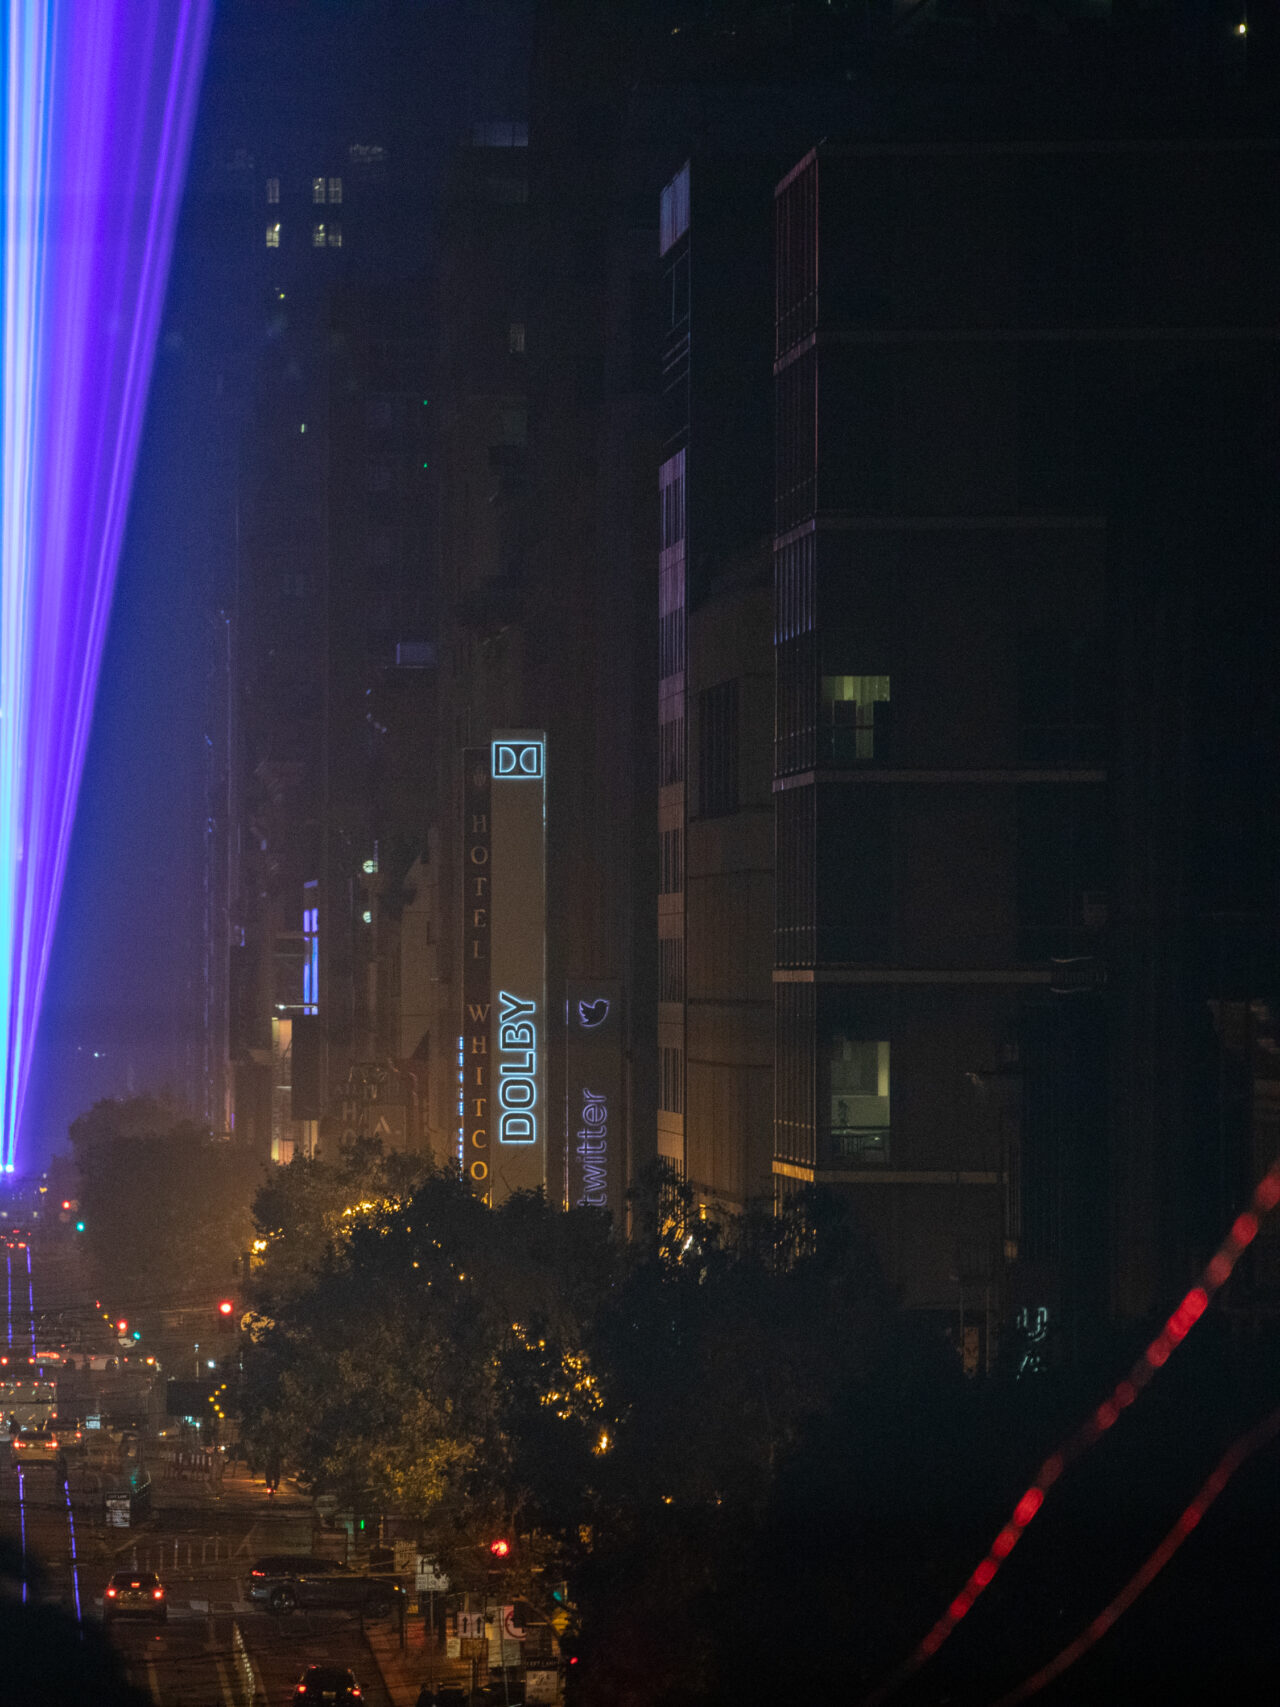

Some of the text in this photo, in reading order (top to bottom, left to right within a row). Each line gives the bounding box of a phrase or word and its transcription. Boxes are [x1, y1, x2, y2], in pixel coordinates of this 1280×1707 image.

[470, 814, 489, 960] HOTEL
[499, 990, 536, 1144] DOLBY
[577, 1087, 608, 1207] twitter
